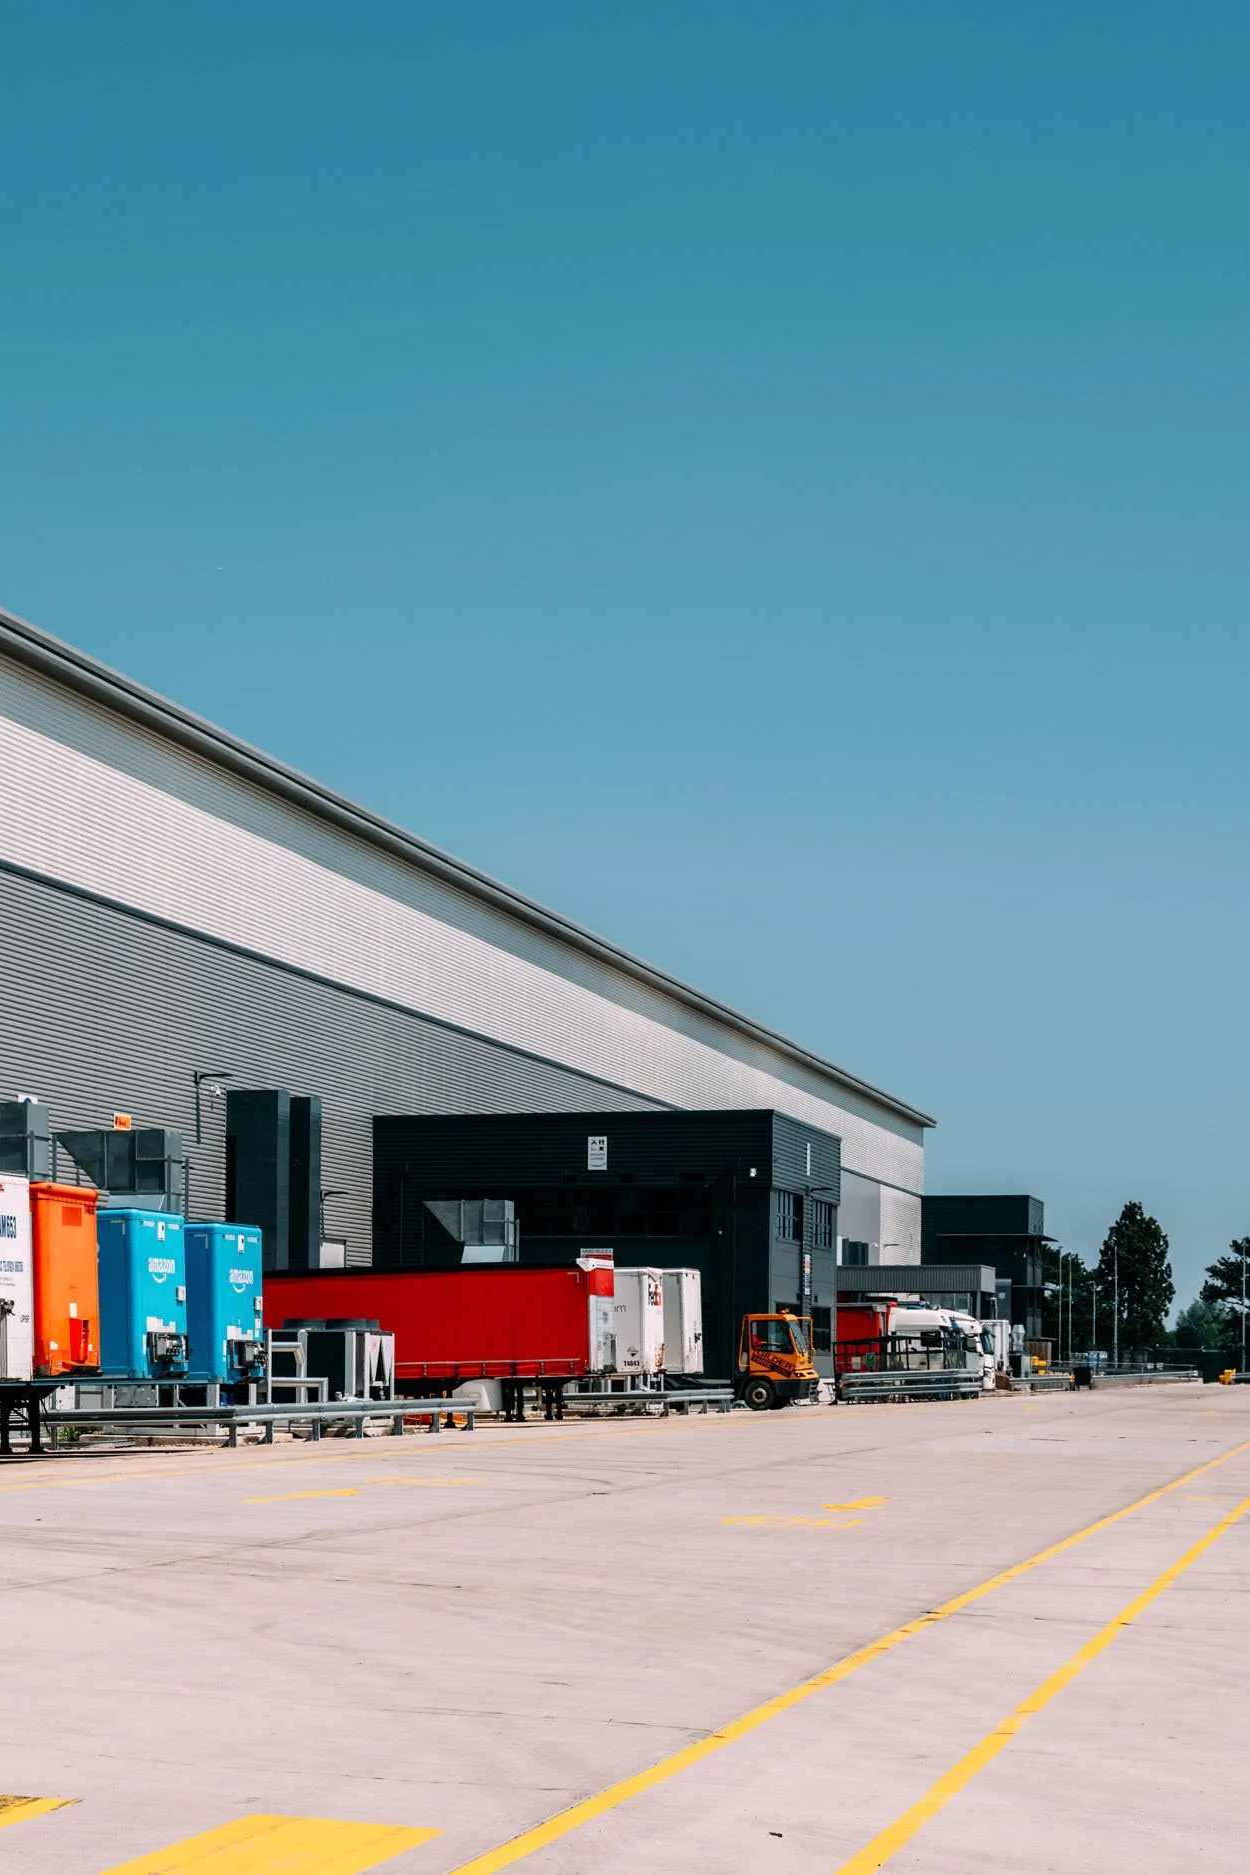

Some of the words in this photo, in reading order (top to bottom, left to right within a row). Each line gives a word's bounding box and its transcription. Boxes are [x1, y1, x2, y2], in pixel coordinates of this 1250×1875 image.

[148, 1257, 175, 1274] amazon
[229, 1268, 253, 1284] amazon
[755, 1350, 793, 1372] GILDER
